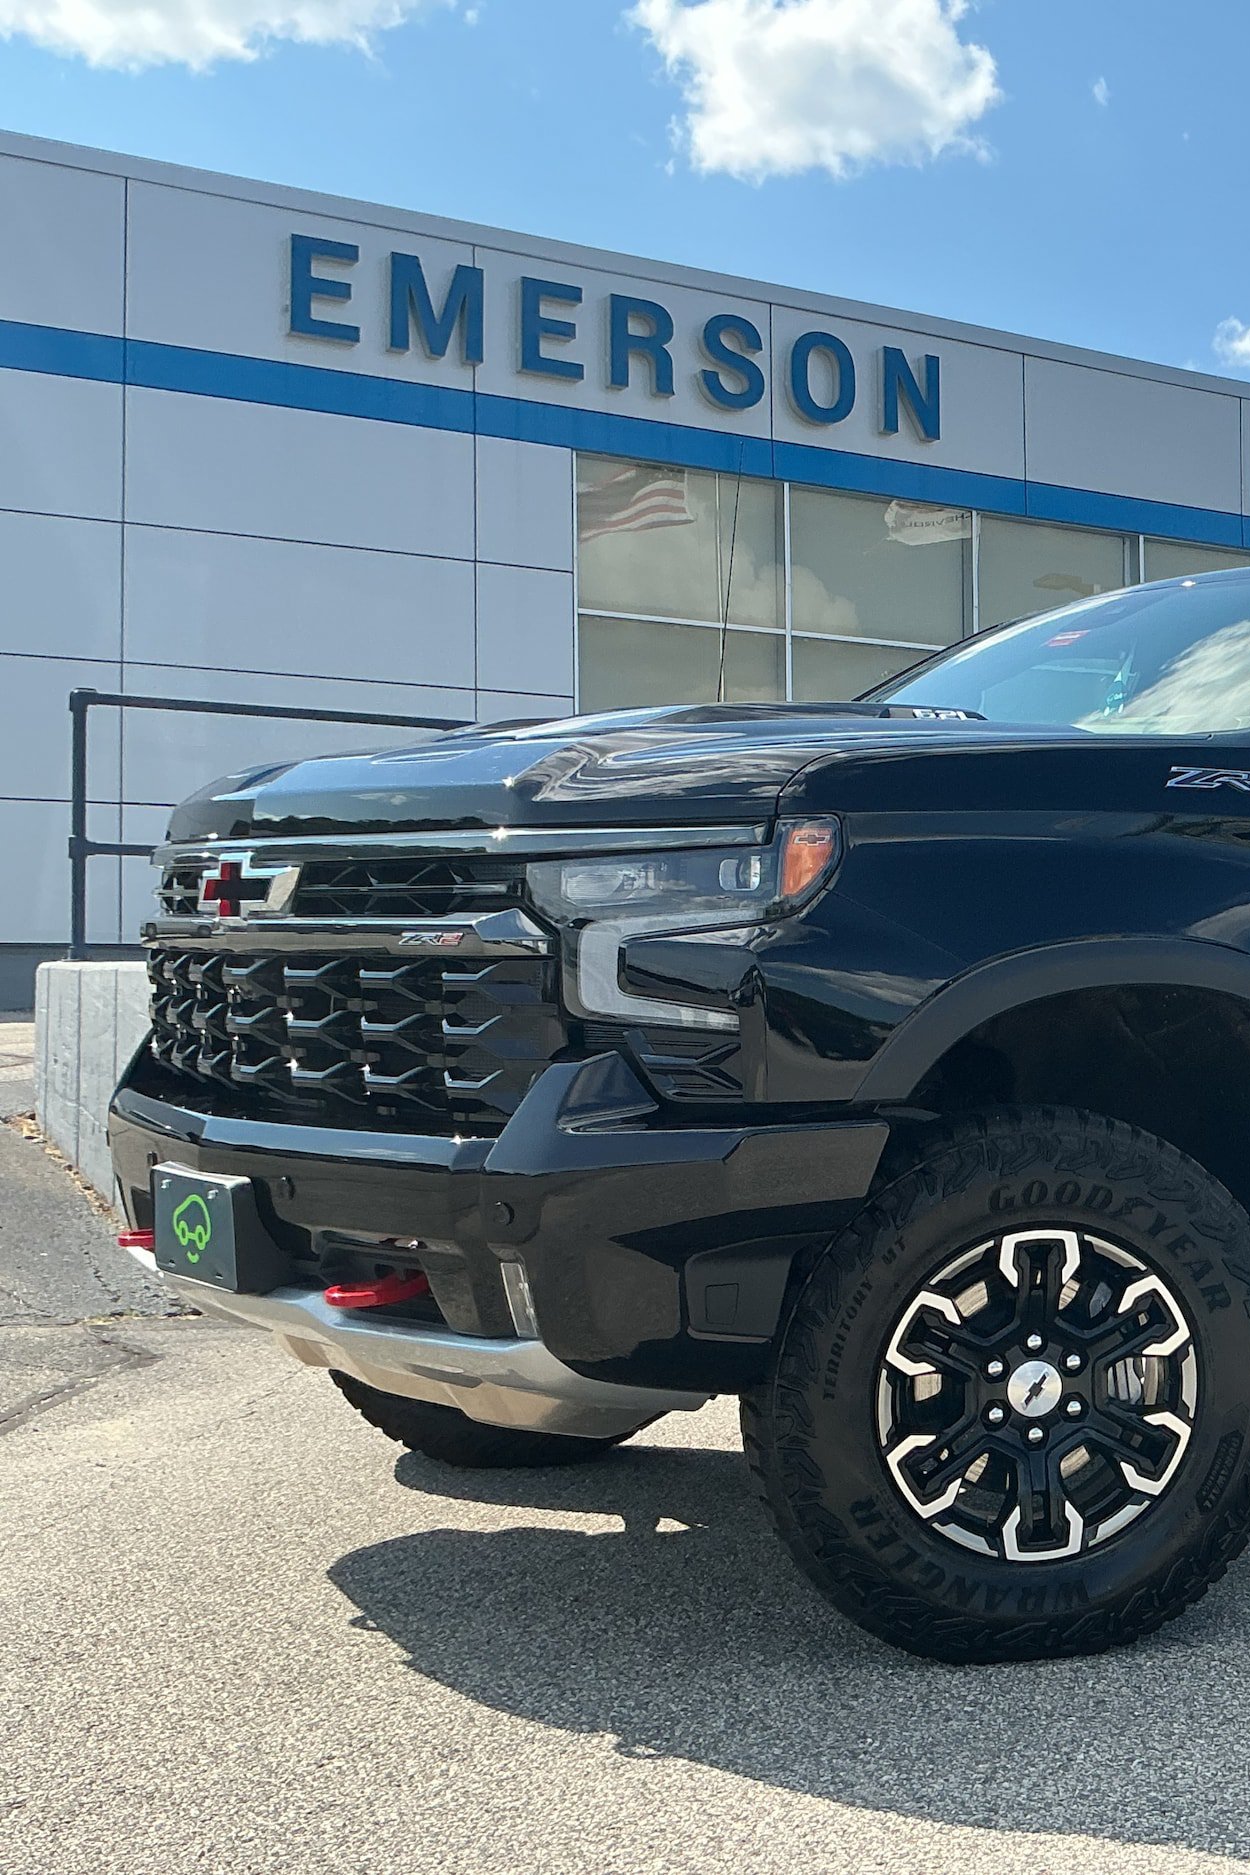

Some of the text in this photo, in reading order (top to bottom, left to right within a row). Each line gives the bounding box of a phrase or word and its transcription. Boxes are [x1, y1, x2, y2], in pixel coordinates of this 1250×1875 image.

[288, 234, 942, 442] EMERSON
[399, 932, 463, 946] ZR2
[989, 1180, 1232, 1313] GOODYEAR
[823, 1276, 873, 1400] TERRITORY
[849, 1497, 1089, 1615] WRANGLER
